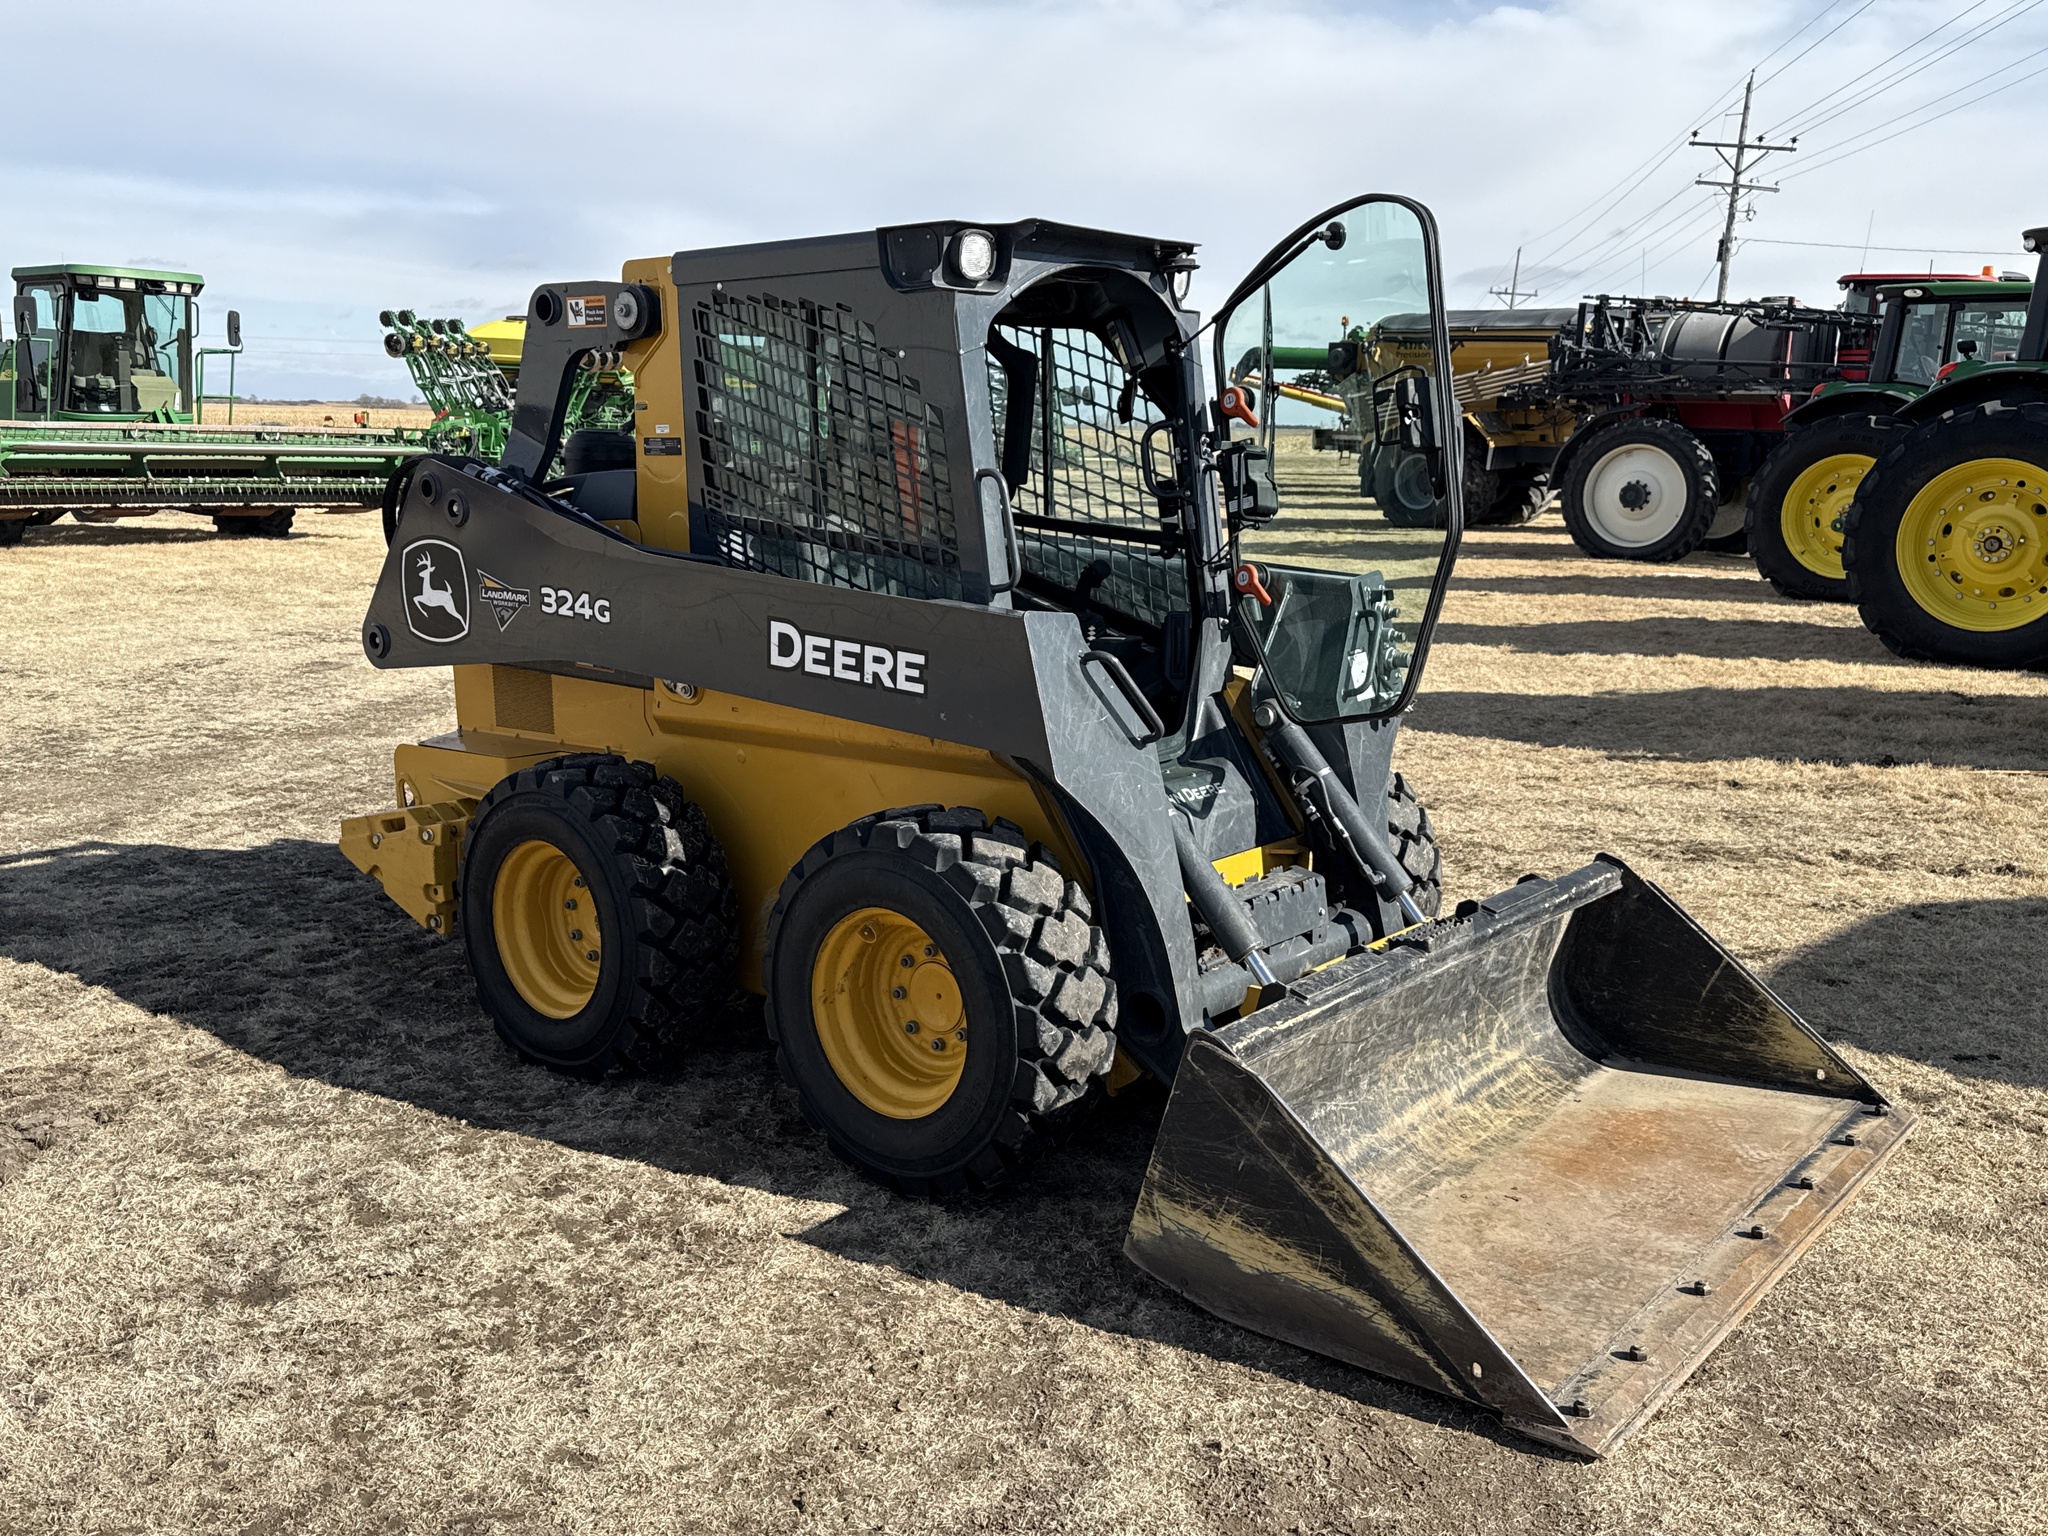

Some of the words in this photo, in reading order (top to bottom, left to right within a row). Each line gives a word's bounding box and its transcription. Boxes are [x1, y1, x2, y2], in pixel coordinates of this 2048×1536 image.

[1396, 351, 1431, 359] Precision
[493, 600, 519, 608] WORKSITE
[541, 587, 610, 623] 324G
[770, 620, 926, 694] DEERE
[1181, 782, 1226, 802] DEERE
